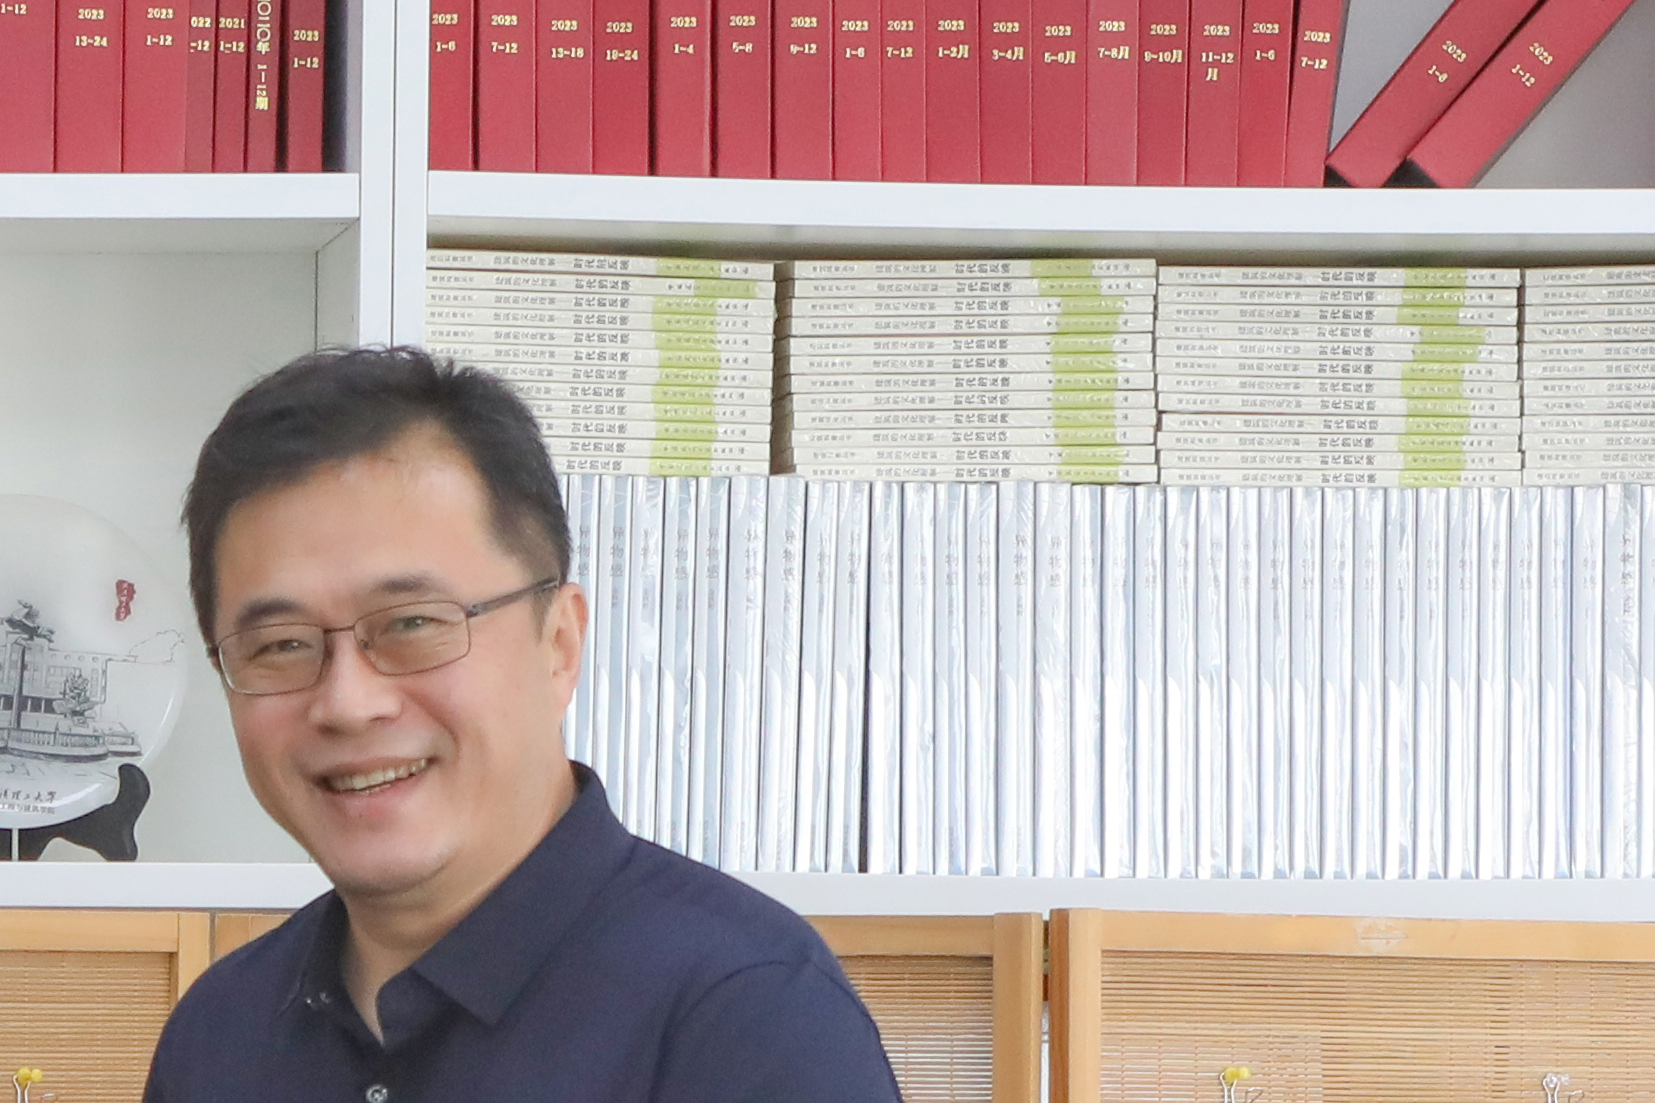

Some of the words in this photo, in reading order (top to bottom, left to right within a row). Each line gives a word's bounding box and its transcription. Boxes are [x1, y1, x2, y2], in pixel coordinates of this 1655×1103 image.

[0, 3, 27, 15] 1-12
[77, 8, 105, 20] 2023
[147, 7, 174, 19] 2023
[190, 16, 211, 28] 022
[219, 17, 245, 29] 2021
[431, 13, 458, 25] 2023
[491, 14, 518, 26] 2023
[551, 19, 578, 31] 2023
[670, 16, 697, 28] 2023
[729, 15, 756, 27] 2023
[790, 16, 818, 28] 2023
[937, 19, 965, 31] 2023
[606, 21, 633, 33] 2023
[841, 20, 869, 31] 2023
[887, 20, 914, 31] 2023
[993, 21, 1020, 33] 2023
[1045, 25, 1072, 37] 2023
[1098, 20, 1126, 32] 2023
[1150, 23, 1177, 36] 2023
[1203, 24, 1230, 36] 2023
[1252, 22, 1279, 34] 2023
[75, 35, 108, 47] 13-24
[146, 34, 173, 46] 1-12
[293, 29, 319, 42] 2023
[1303, 30, 1331, 43] 2023
[190, 39, 210, 53] -12
[219, 40, 245, 54] 1-12
[436, 40, 456, 52] 1-6
[491, 41, 518, 54] 7-12
[674, 43, 694, 54] 1-4
[886, 46, 913, 58] 7-12
[938, 44, 969, 59] 1-2月
[1442, 40, 1467, 63] 2023
[551, 47, 584, 59] 13-18
[845, 46, 865, 59] 1-6
[1098, 45, 1130, 60] 7-8月
[1201, 51, 1234, 64] 11-12
[1255, 49, 1275, 61] 1-6
[1529, 42, 1553, 65] 2023
[293, 57, 319, 69] 1-12
[1301, 56, 1328, 69] 7-12
[1427, 65, 1448, 83] 1-6
[1511, 64, 1536, 87] 1-12
